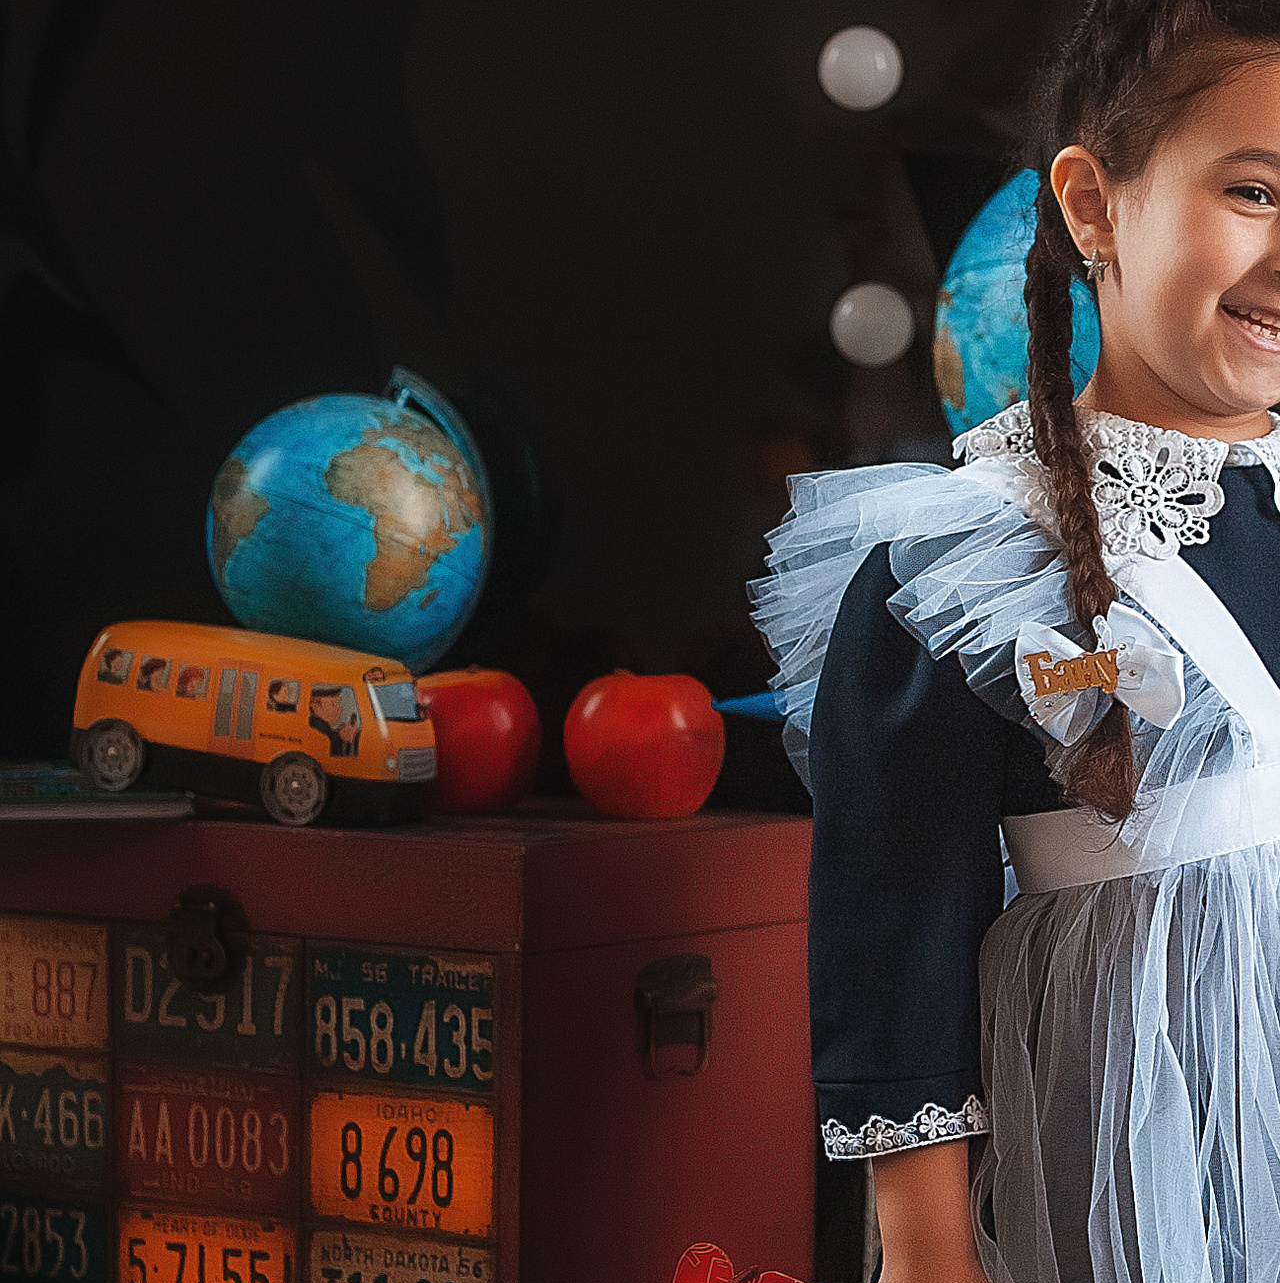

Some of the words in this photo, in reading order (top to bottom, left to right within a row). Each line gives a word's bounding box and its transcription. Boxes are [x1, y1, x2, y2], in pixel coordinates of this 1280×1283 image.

[32, 958, 98, 1022] 887
[321, 1242, 374, 1266] NORTH
[384, 1249, 449, 1274] DAKOTA
